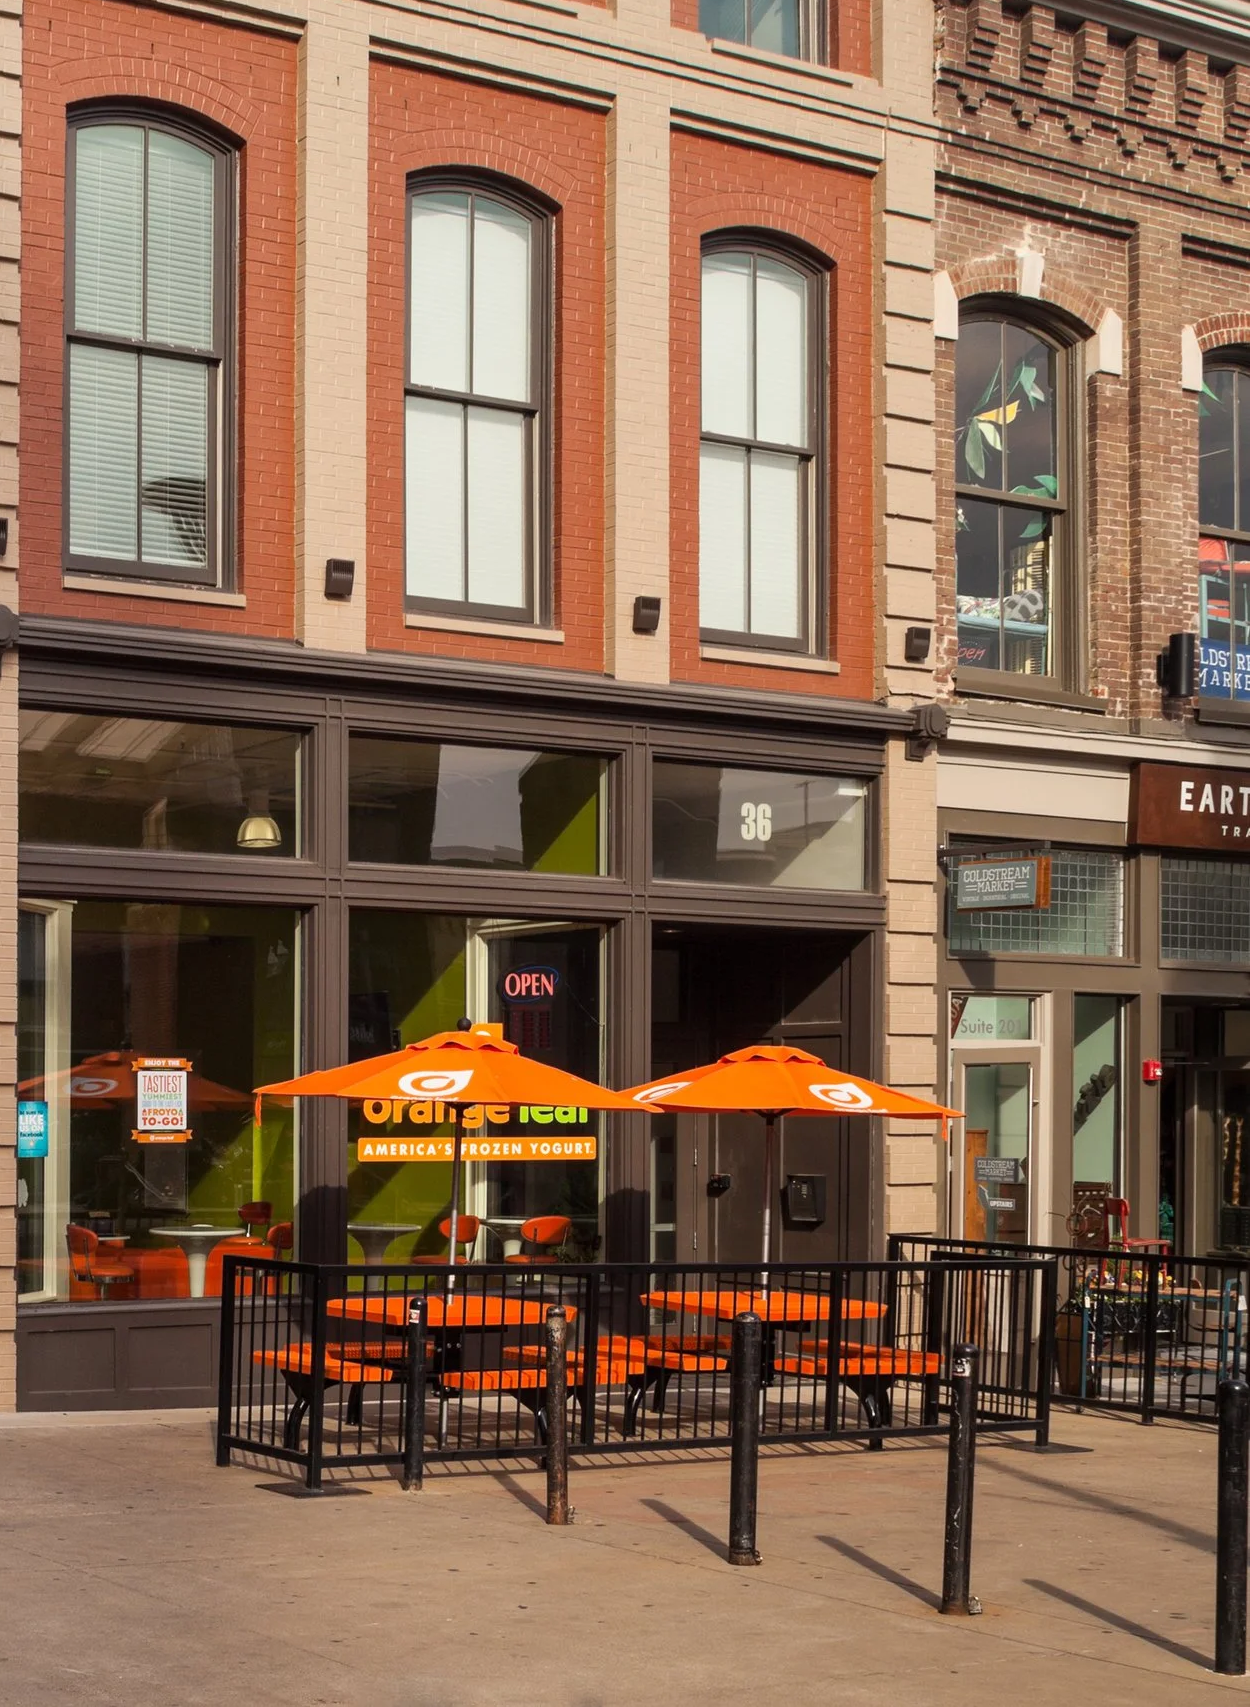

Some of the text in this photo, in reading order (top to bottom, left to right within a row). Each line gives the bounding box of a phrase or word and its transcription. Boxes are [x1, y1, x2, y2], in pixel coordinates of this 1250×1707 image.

[1180, 781, 1250, 816] EART
[741, 802, 772, 841] 36
[963, 866, 1030, 883] COLDSTREAM
[977, 880, 1016, 893] MARKET
[505, 973, 554, 997] OPEN
[960, 1018, 993, 1034] Suite
[142, 1075, 183, 1093] TASTIEST
[142, 1093, 183, 1101] YUMMIEST
[148, 1108, 178, 1116] FROYO
[363, 1099, 510, 1129] orange
[19, 1114, 44, 1125] LIKE
[142, 1117, 183, 1126] TO-GO!
[363, 1141, 591, 1156] AMERICA'S FROZEN YOGURT
[977, 1160, 1015, 1169] COLDSTREAM
[986, 1168, 1007, 1176] MARKET
[990, 1200, 1013, 1208] UPSTAIRS
